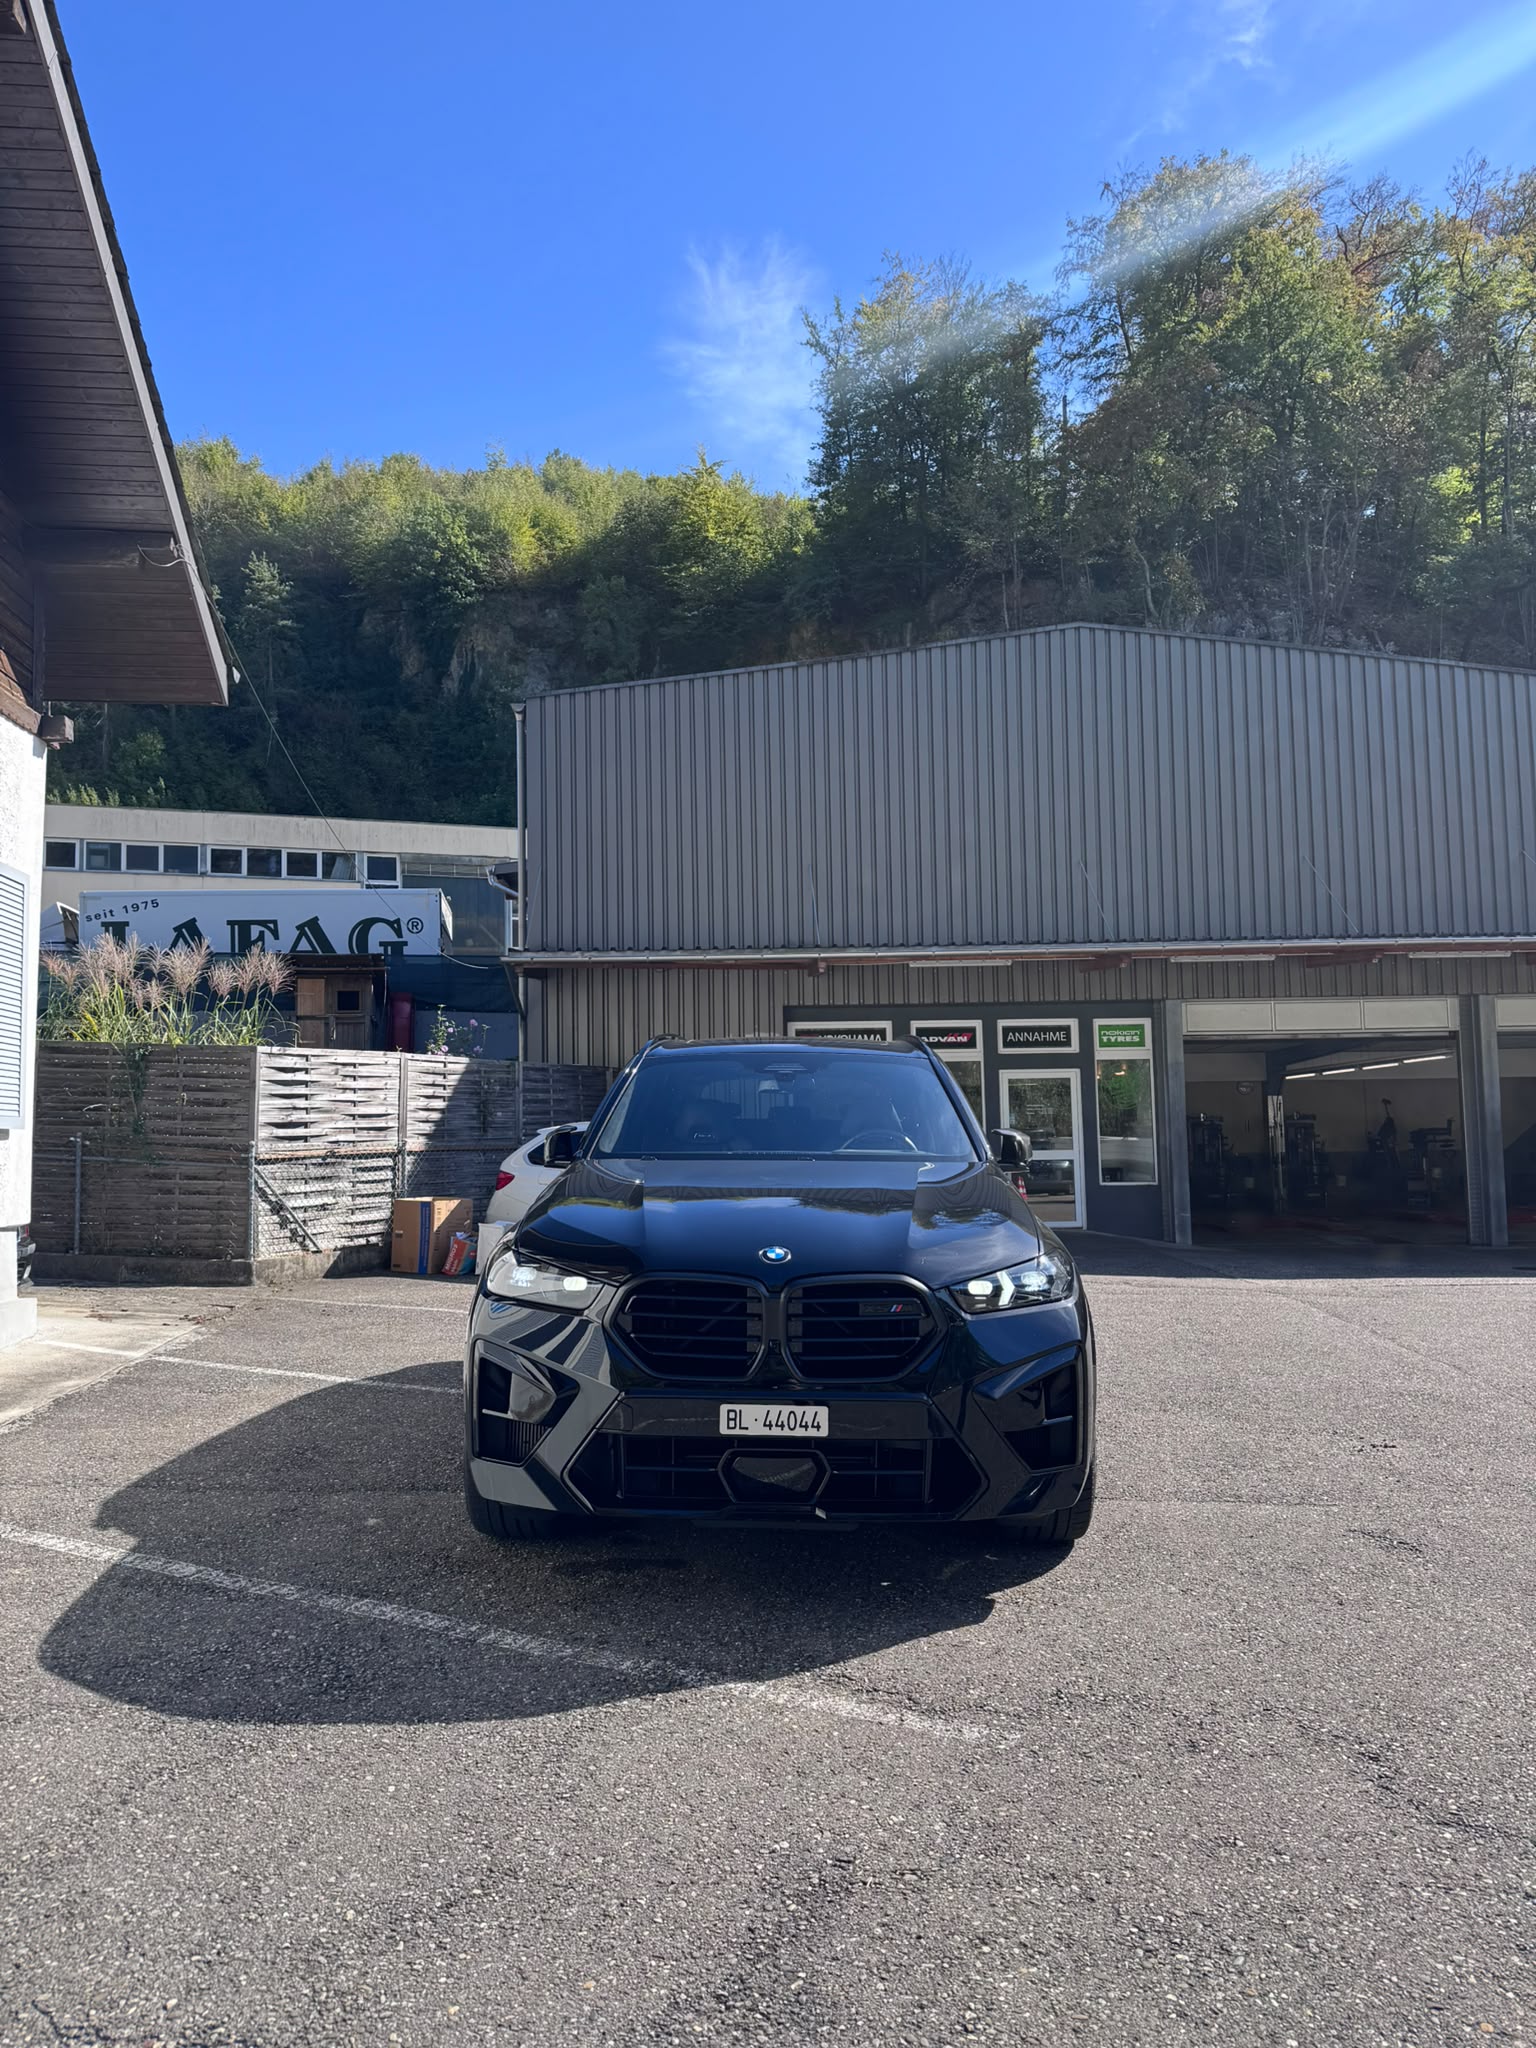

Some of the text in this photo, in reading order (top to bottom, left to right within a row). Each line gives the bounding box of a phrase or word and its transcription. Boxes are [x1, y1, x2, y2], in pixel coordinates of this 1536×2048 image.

[85, 898, 160, 922] seit 1975
[1006, 1031, 1067, 1042] ANNAHME
